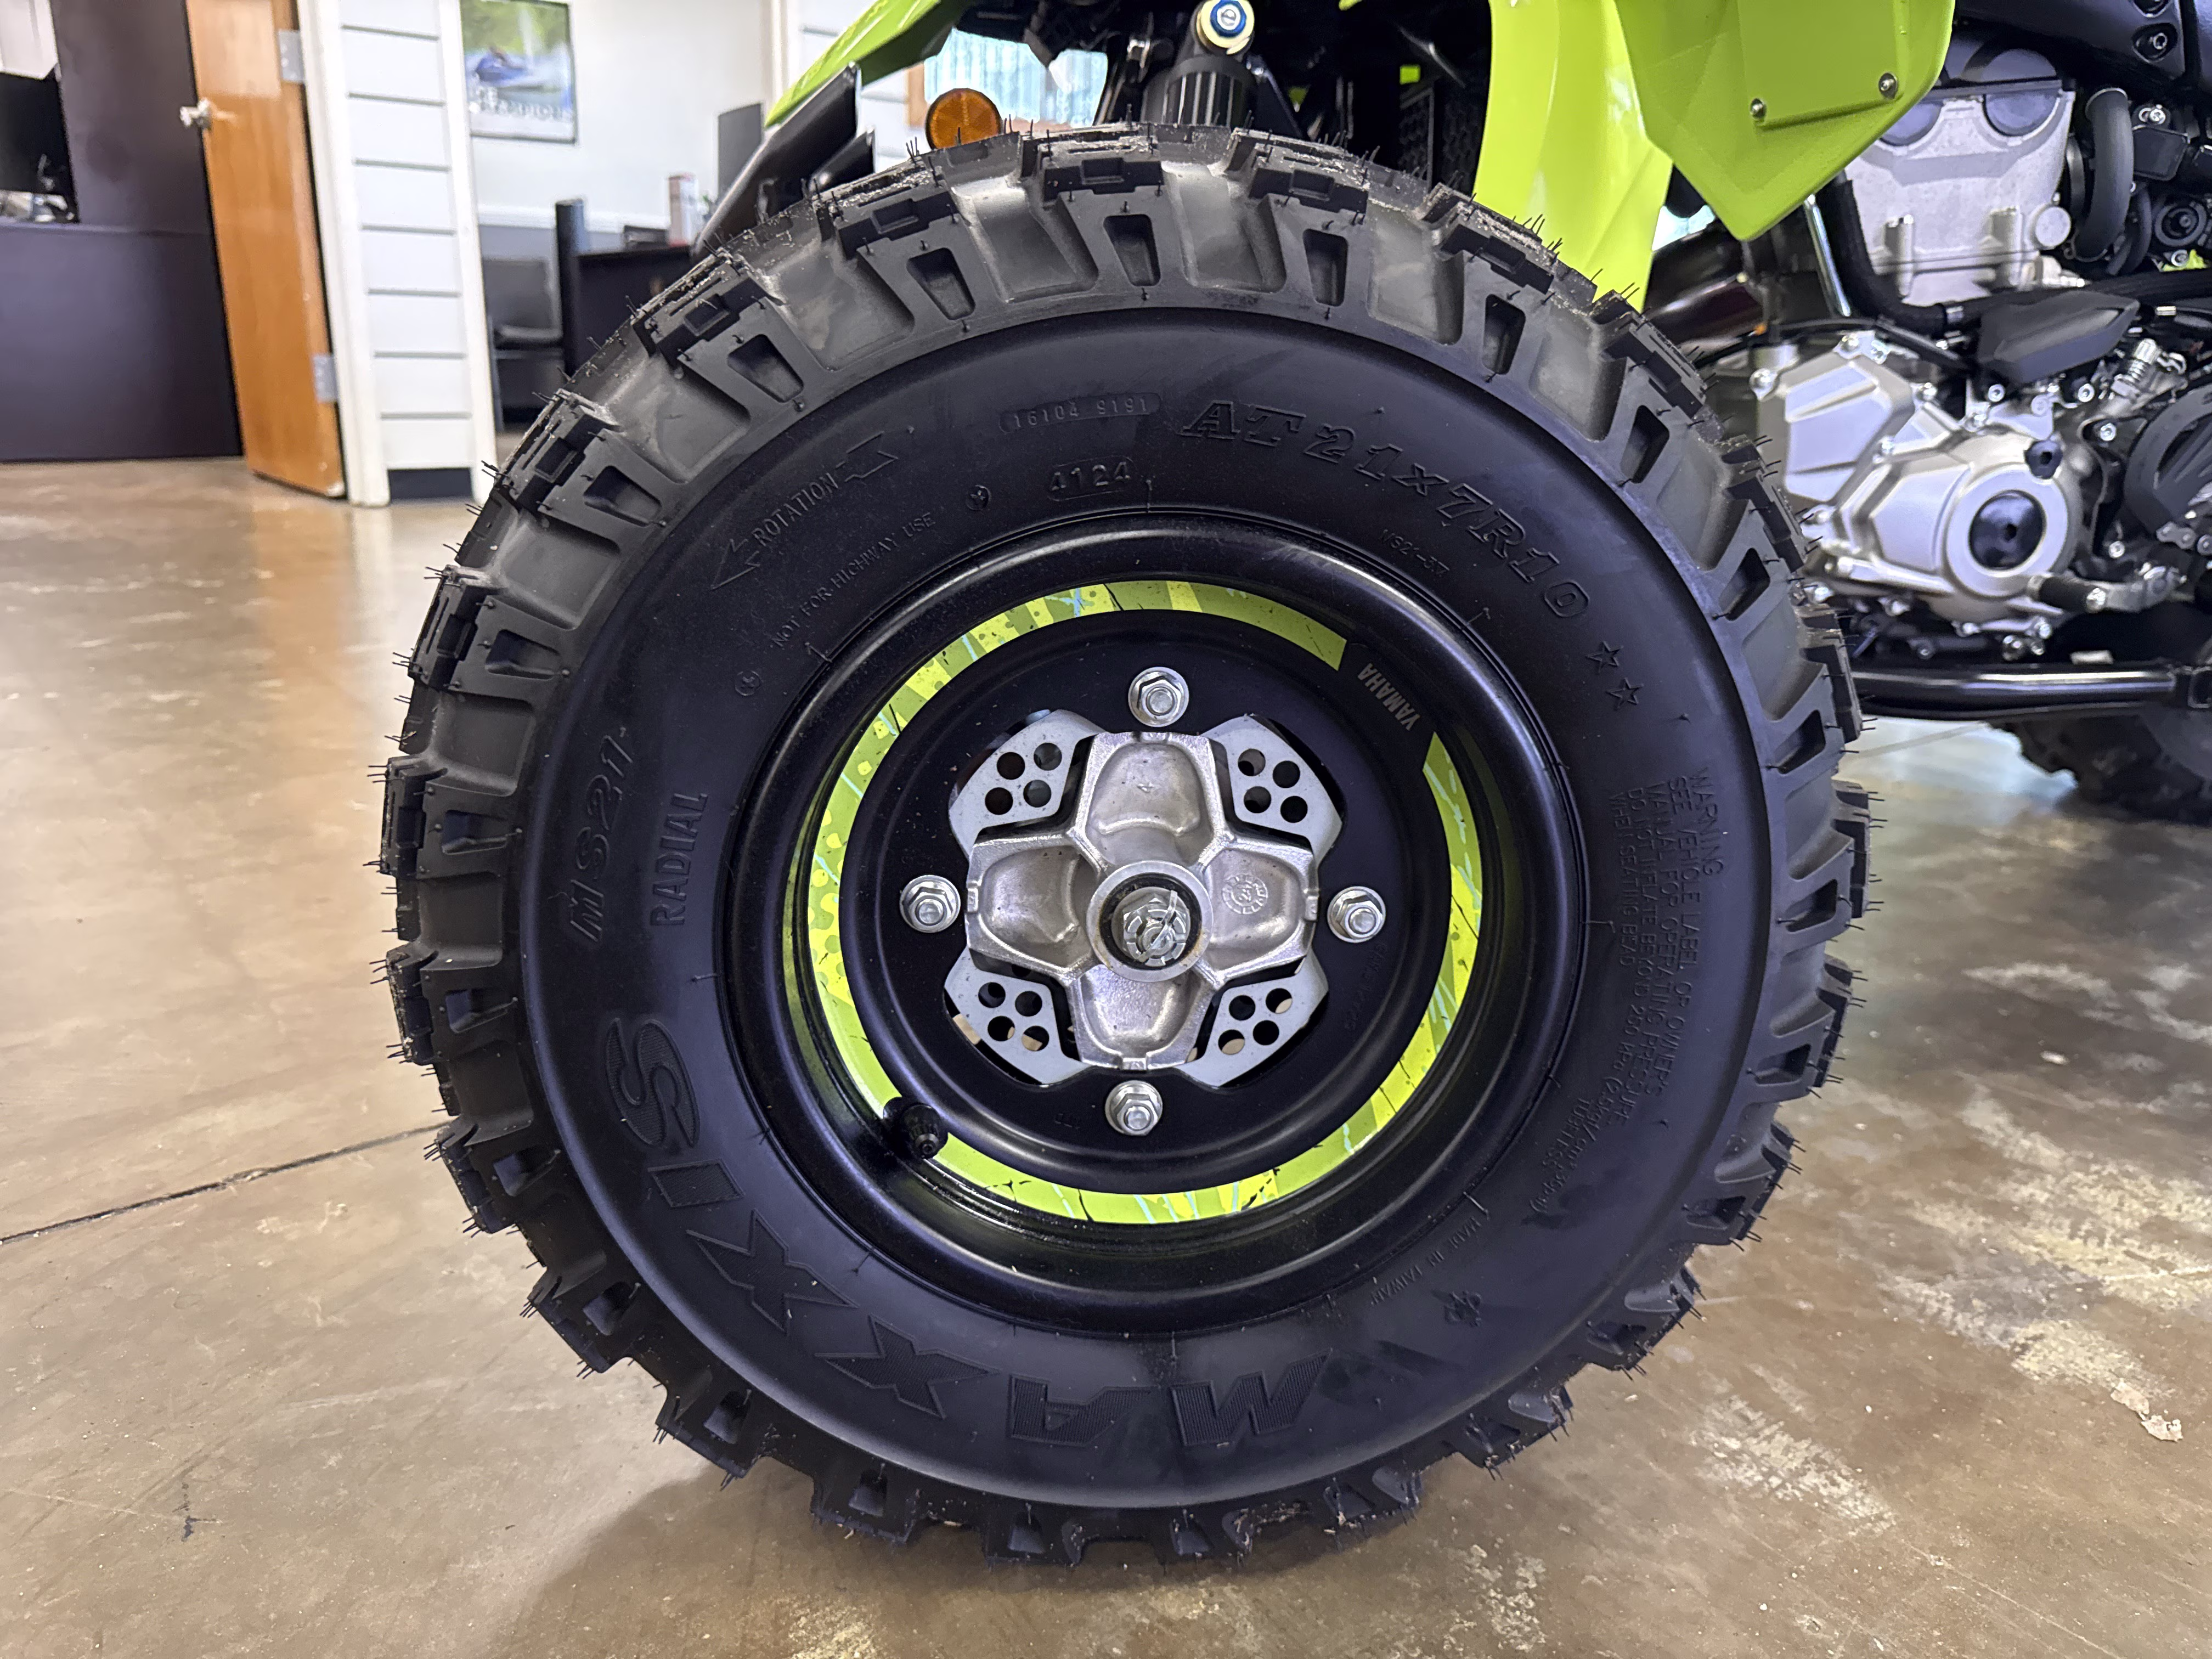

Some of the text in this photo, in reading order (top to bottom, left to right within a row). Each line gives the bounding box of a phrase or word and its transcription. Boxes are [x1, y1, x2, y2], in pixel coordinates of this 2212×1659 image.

[752, 471, 840, 548] ROTATION
[1180, 399, 1590, 618] AT 21x7R10
[773, 512, 937, 648] NOT FOR HIGHWAY USE
[1357, 663, 1420, 731] YAMAHA
[1627, 787, 1647, 811] DO
[1646, 781, 1676, 861] MANUAL
[1667, 776, 1692, 814] SEE
[1690, 767, 1724, 874] WARNING
[650, 792, 708, 927] RADIAL
[1634, 817, 1655, 851] NOT
[1678, 824, 1701, 902] VEHICLE
[1609, 792, 1640, 967] WHEN SEATING BEAD
[1640, 857, 1658, 926] INFLATE
[1658, 868, 1680, 906] FOR
[1633, 933, 1657, 998] BEYOND
[1646, 917, 1680, 1025] OPERATING
[1677, 912, 1700, 971] LABEL
[605, 1017, 1333, 1447] MAXXIS
